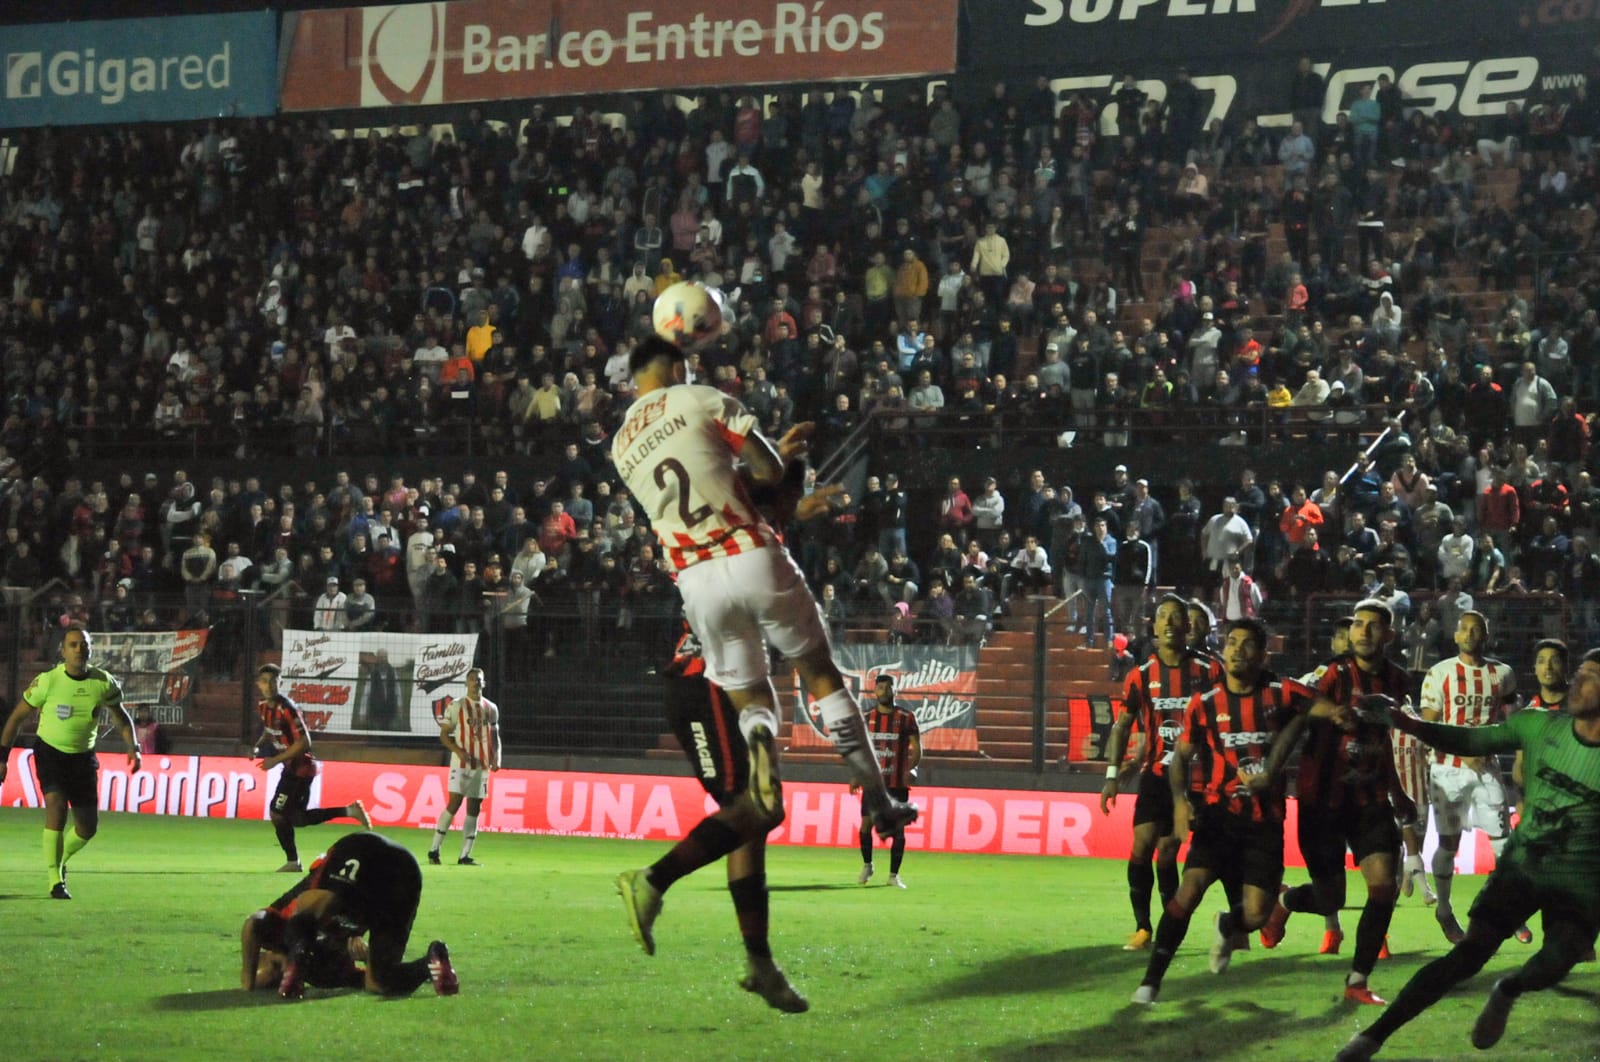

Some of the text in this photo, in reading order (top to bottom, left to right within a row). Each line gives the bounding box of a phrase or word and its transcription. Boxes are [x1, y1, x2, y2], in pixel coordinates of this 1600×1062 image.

[626, 11, 763, 64] Entre
[775, 2, 885, 54] Ríos
[48, 42, 230, 104] Gigared
[620, 414, 687, 481] CALDERON
[653, 457, 714, 529] 2
[420, 643, 465, 663] Familia
[13, 749, 255, 818] Sneider
[545, 780, 681, 837] UNA
[704, 786, 1092, 856] HNEIDER
